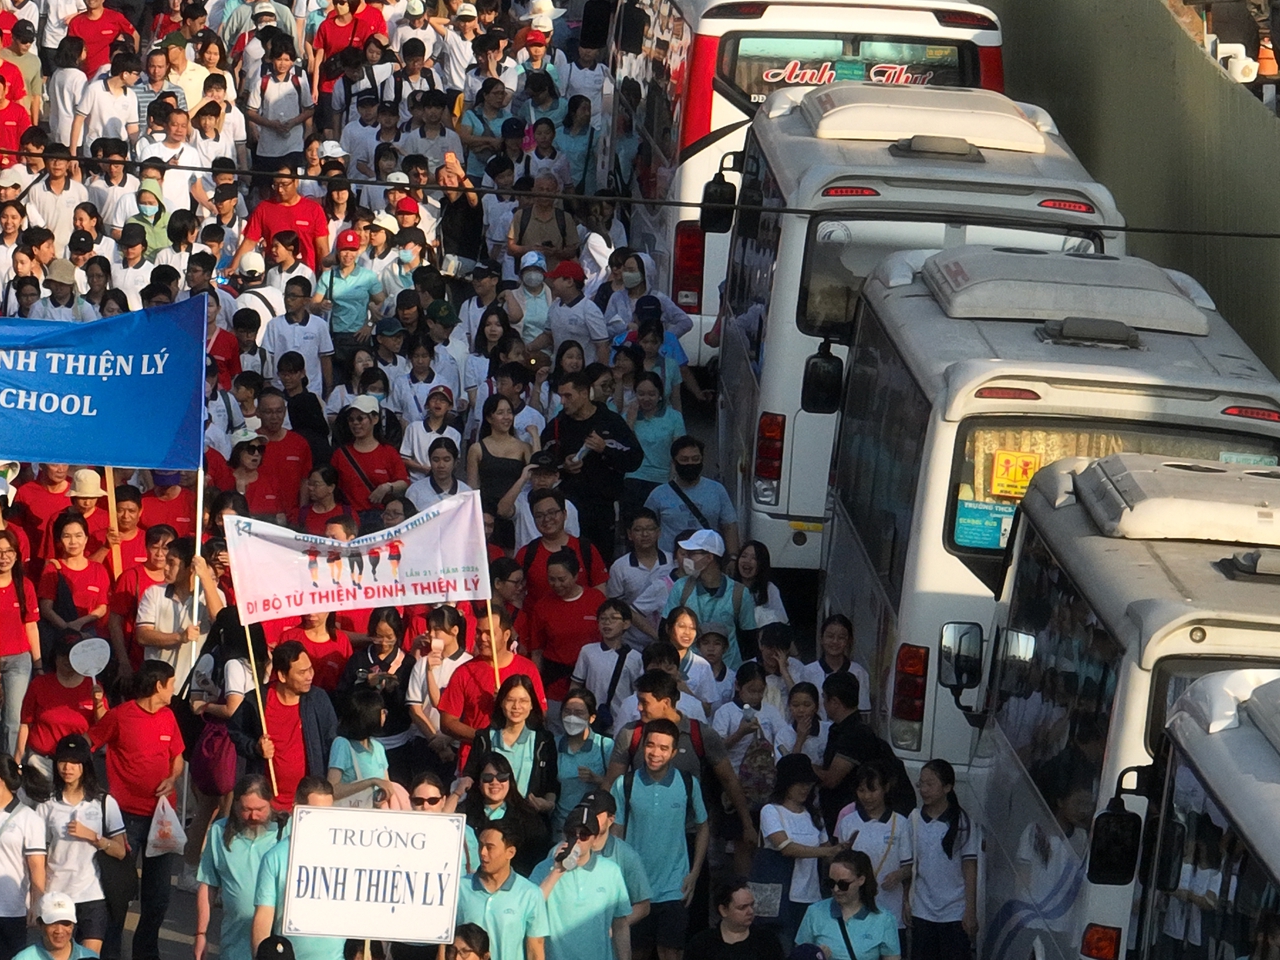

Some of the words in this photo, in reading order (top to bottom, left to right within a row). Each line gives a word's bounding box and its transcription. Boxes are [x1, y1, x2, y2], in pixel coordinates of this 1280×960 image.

[763, 60, 835, 84] Anh
[45, 350, 134, 381] THIỆN
[140, 347, 170, 376] LÝ
[246, 601, 258, 615] ĐI
[262, 592, 283, 614] BỘ
[287, 589, 304, 607] TỪ
[309, 586, 358, 606] THIỆN
[363, 583, 405, 600] ĐINH
[411, 578, 458, 597] THIỆN
[464, 574, 481, 591] LÝ
[329, 826, 426, 850] TRƯỜNG
[295, 865, 348, 901] ĐINH
[354, 864, 418, 914] THIỆN
[421, 862, 451, 907] LÝ
